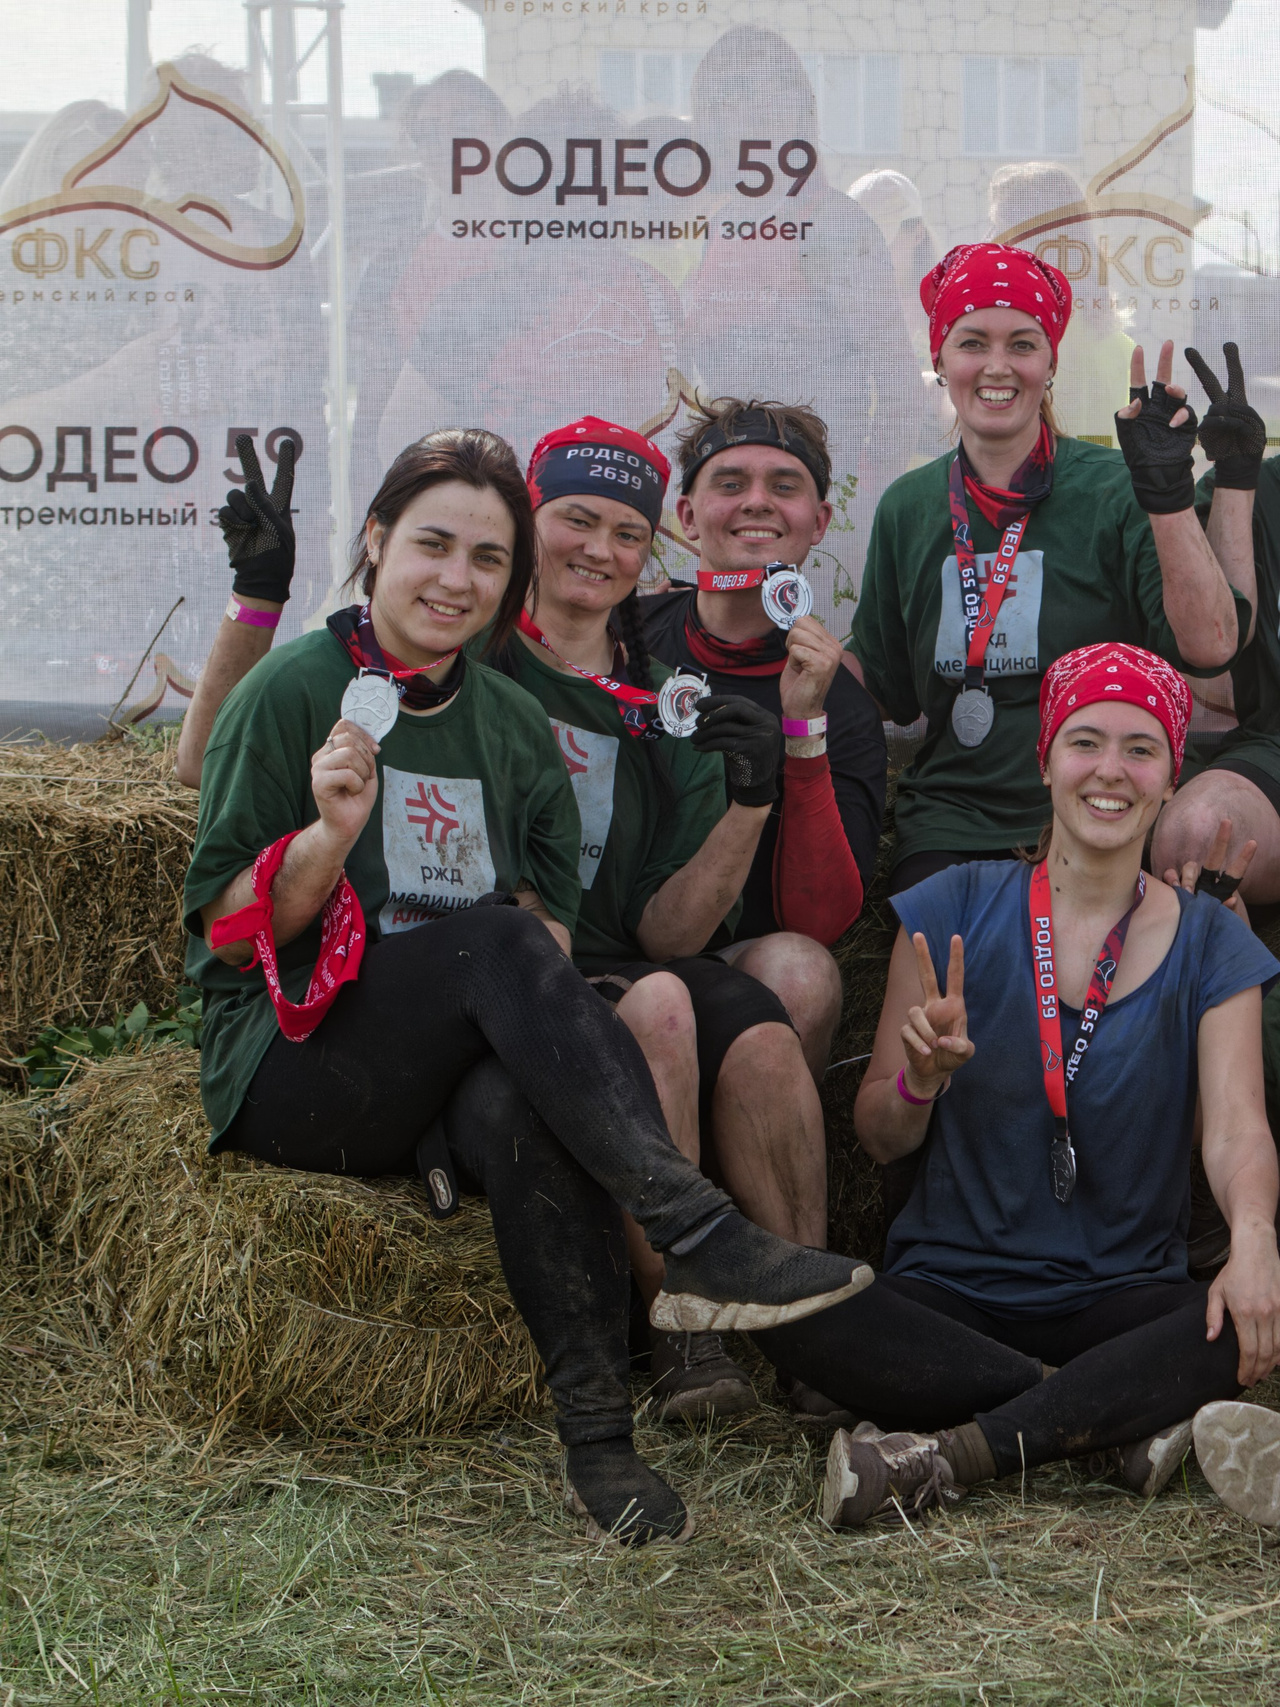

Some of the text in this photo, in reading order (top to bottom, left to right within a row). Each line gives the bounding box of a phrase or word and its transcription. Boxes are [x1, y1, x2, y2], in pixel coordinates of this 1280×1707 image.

[451, 137, 818, 206] РОДЕО 59
[451, 215, 813, 245] экстремальный забег
[11, 228, 160, 280] ФКС
[1034, 234, 1185, 287] ФКС
[0, 288, 195, 305] ермский край
[1074, 296, 1220, 313] ский край
[0, 425, 199, 492] ОДЕО
[566, 447, 659, 484] РОДЕО 59
[589, 464, 642, 490] 2639
[0, 502, 197, 531] тремальный
[712, 573, 748, 590] РОДЕО 59
[962, 567, 976, 588] 59
[992, 562, 1010, 584] 59
[597, 677, 621, 691] 59
[672, 726, 683, 738] 59
[421, 866, 463, 886] ржд
[1035, 916, 1057, 1019] РОДЕО 59
[1080, 1007, 1099, 1033] 59
